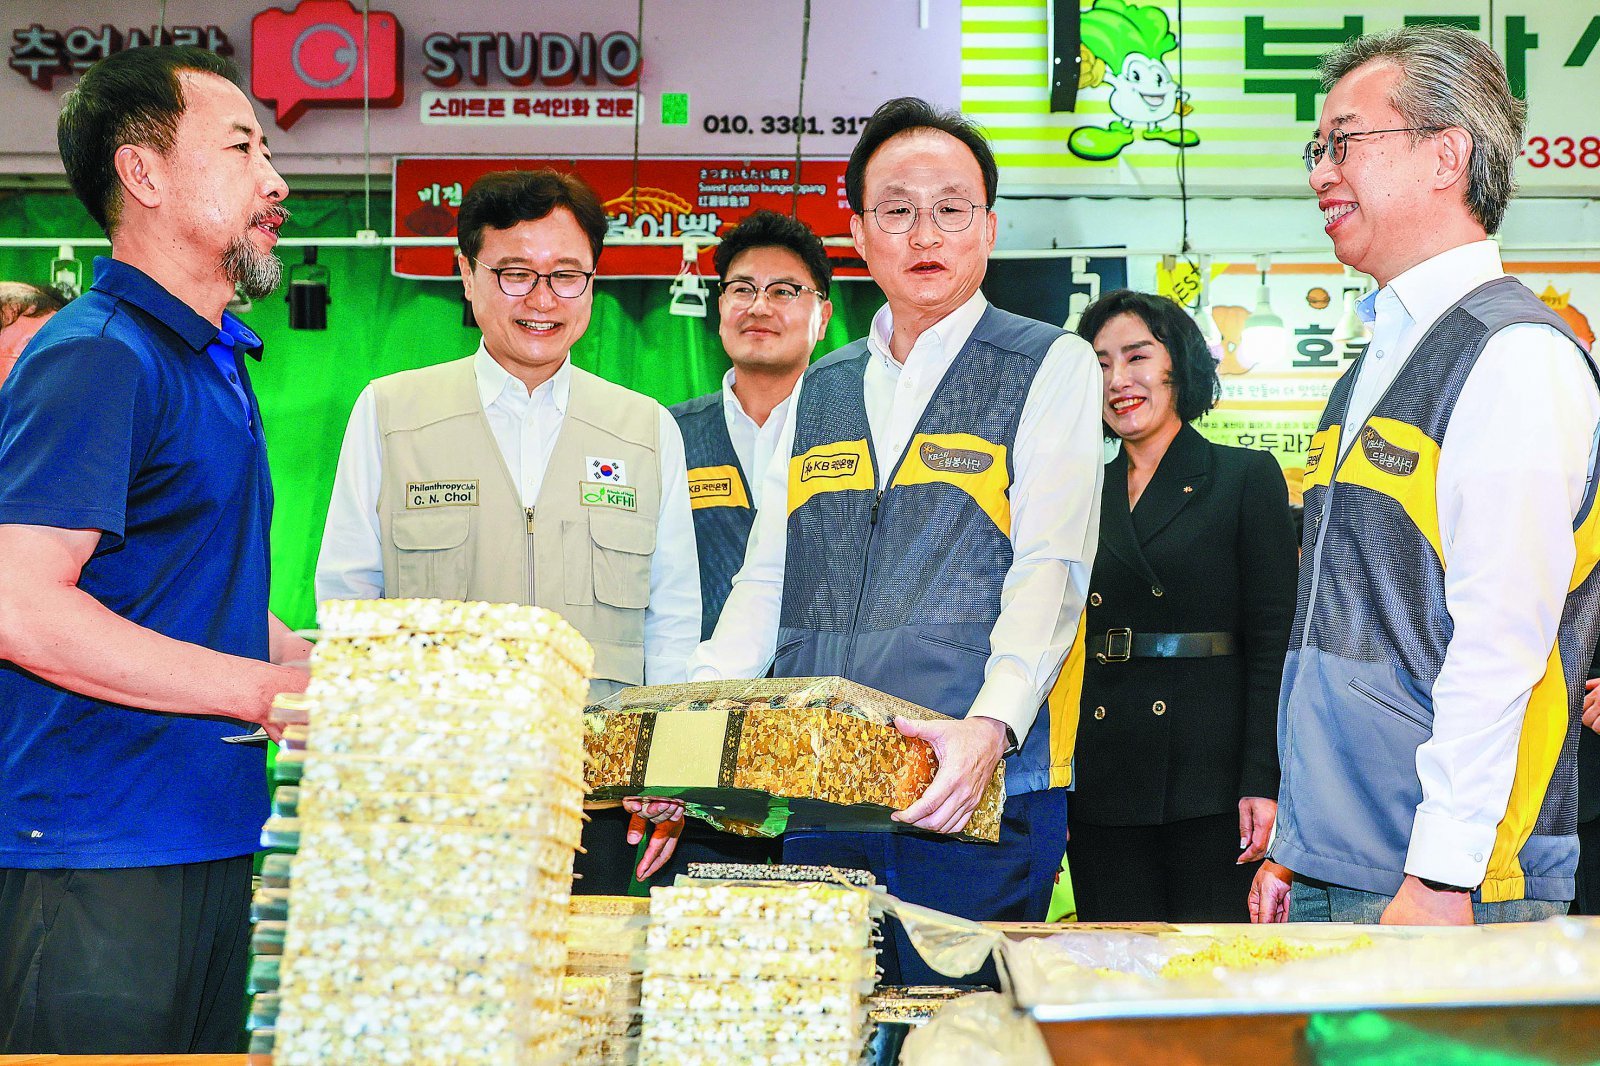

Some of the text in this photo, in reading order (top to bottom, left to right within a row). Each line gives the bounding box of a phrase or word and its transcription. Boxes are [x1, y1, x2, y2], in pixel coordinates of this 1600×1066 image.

[424, 32, 640, 82] STUDIO
[429, 98, 634, 117] 스마트폰 즉석인화 전문
[704, 115, 754, 135] 010.
[761, 116, 824, 135] 3381.
[698, 182, 727, 193] Sweet
[728, 183, 760, 195] potato
[813, 460, 830, 471] KB
[1369, 451, 1413, 474] 드림봉사단
[607, 493, 634, 507] KFHI
